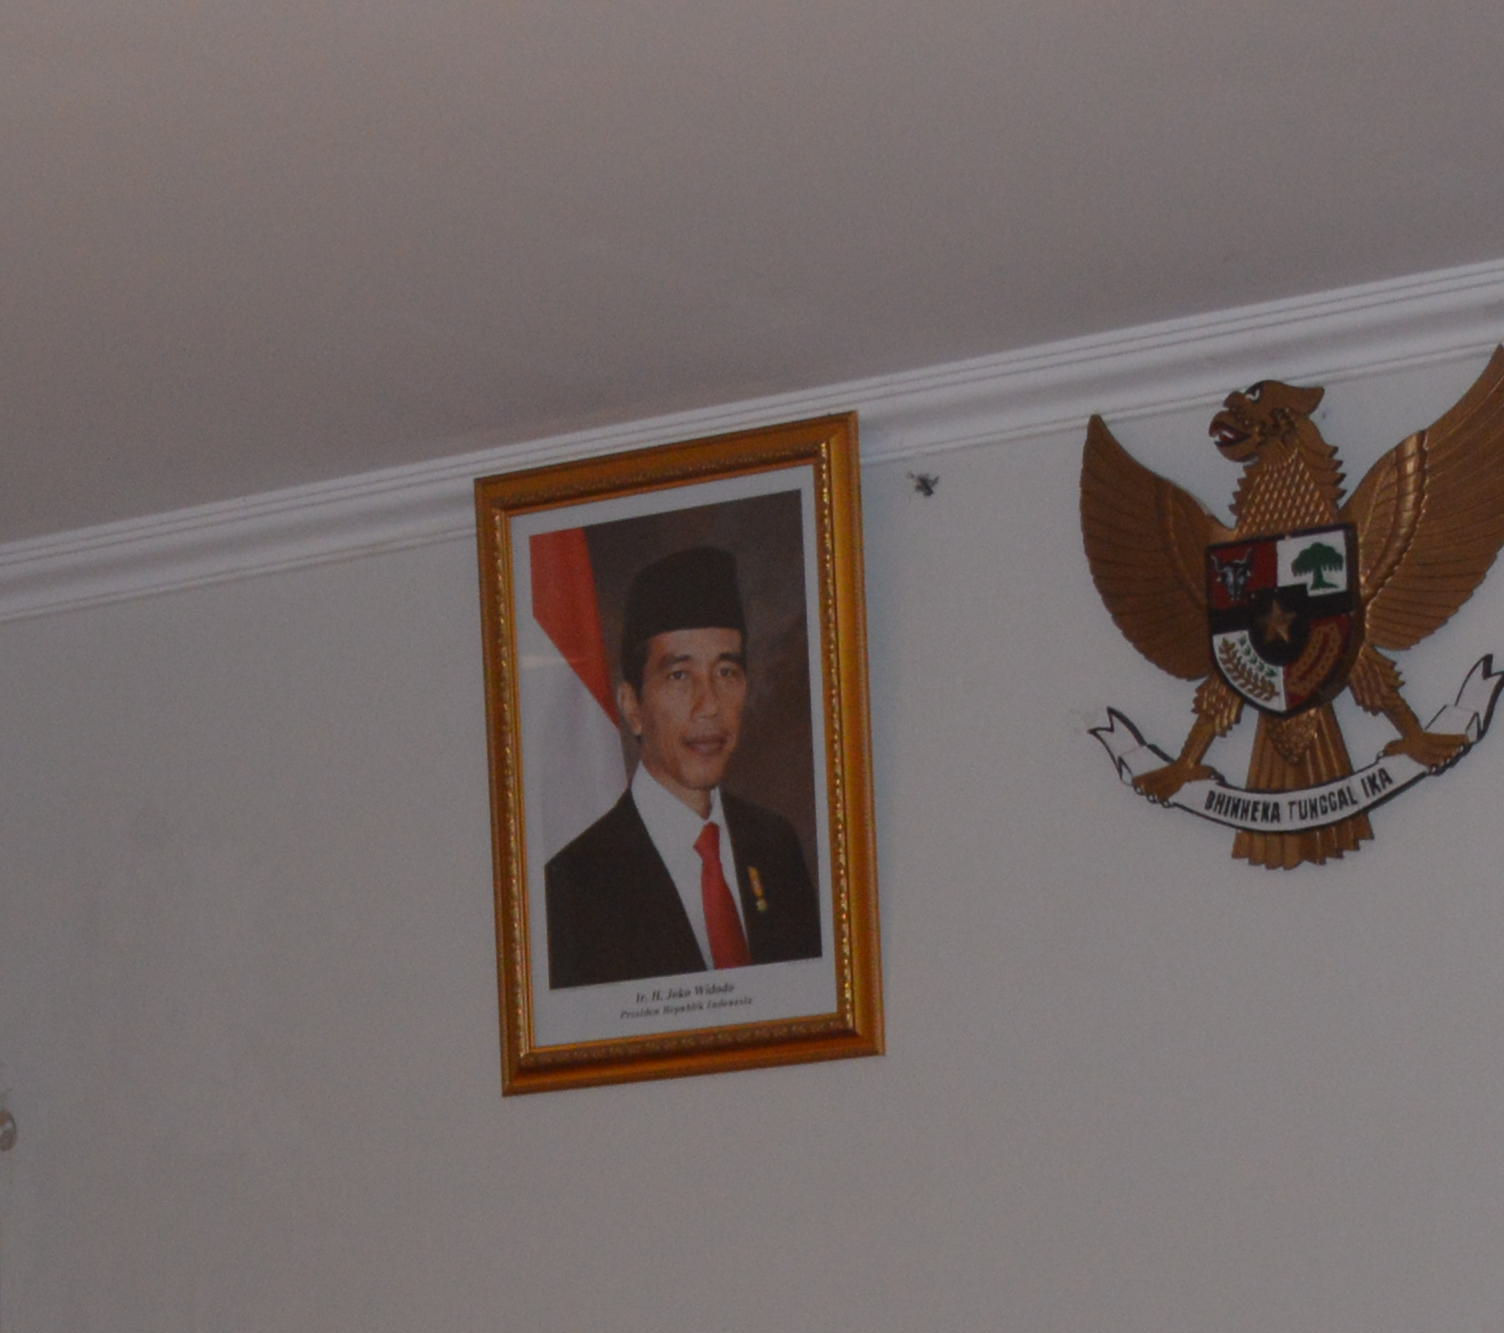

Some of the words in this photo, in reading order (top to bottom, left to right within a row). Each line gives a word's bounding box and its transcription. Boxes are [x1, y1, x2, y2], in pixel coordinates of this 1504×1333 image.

[1205, 790, 1281, 824] BHINNEKA
[1288, 785, 1358, 822] TUNGGAL
[1360, 767, 1394, 799] IKA
[668, 988, 692, 1000] Joko
[695, 983, 736, 996] Widodo
